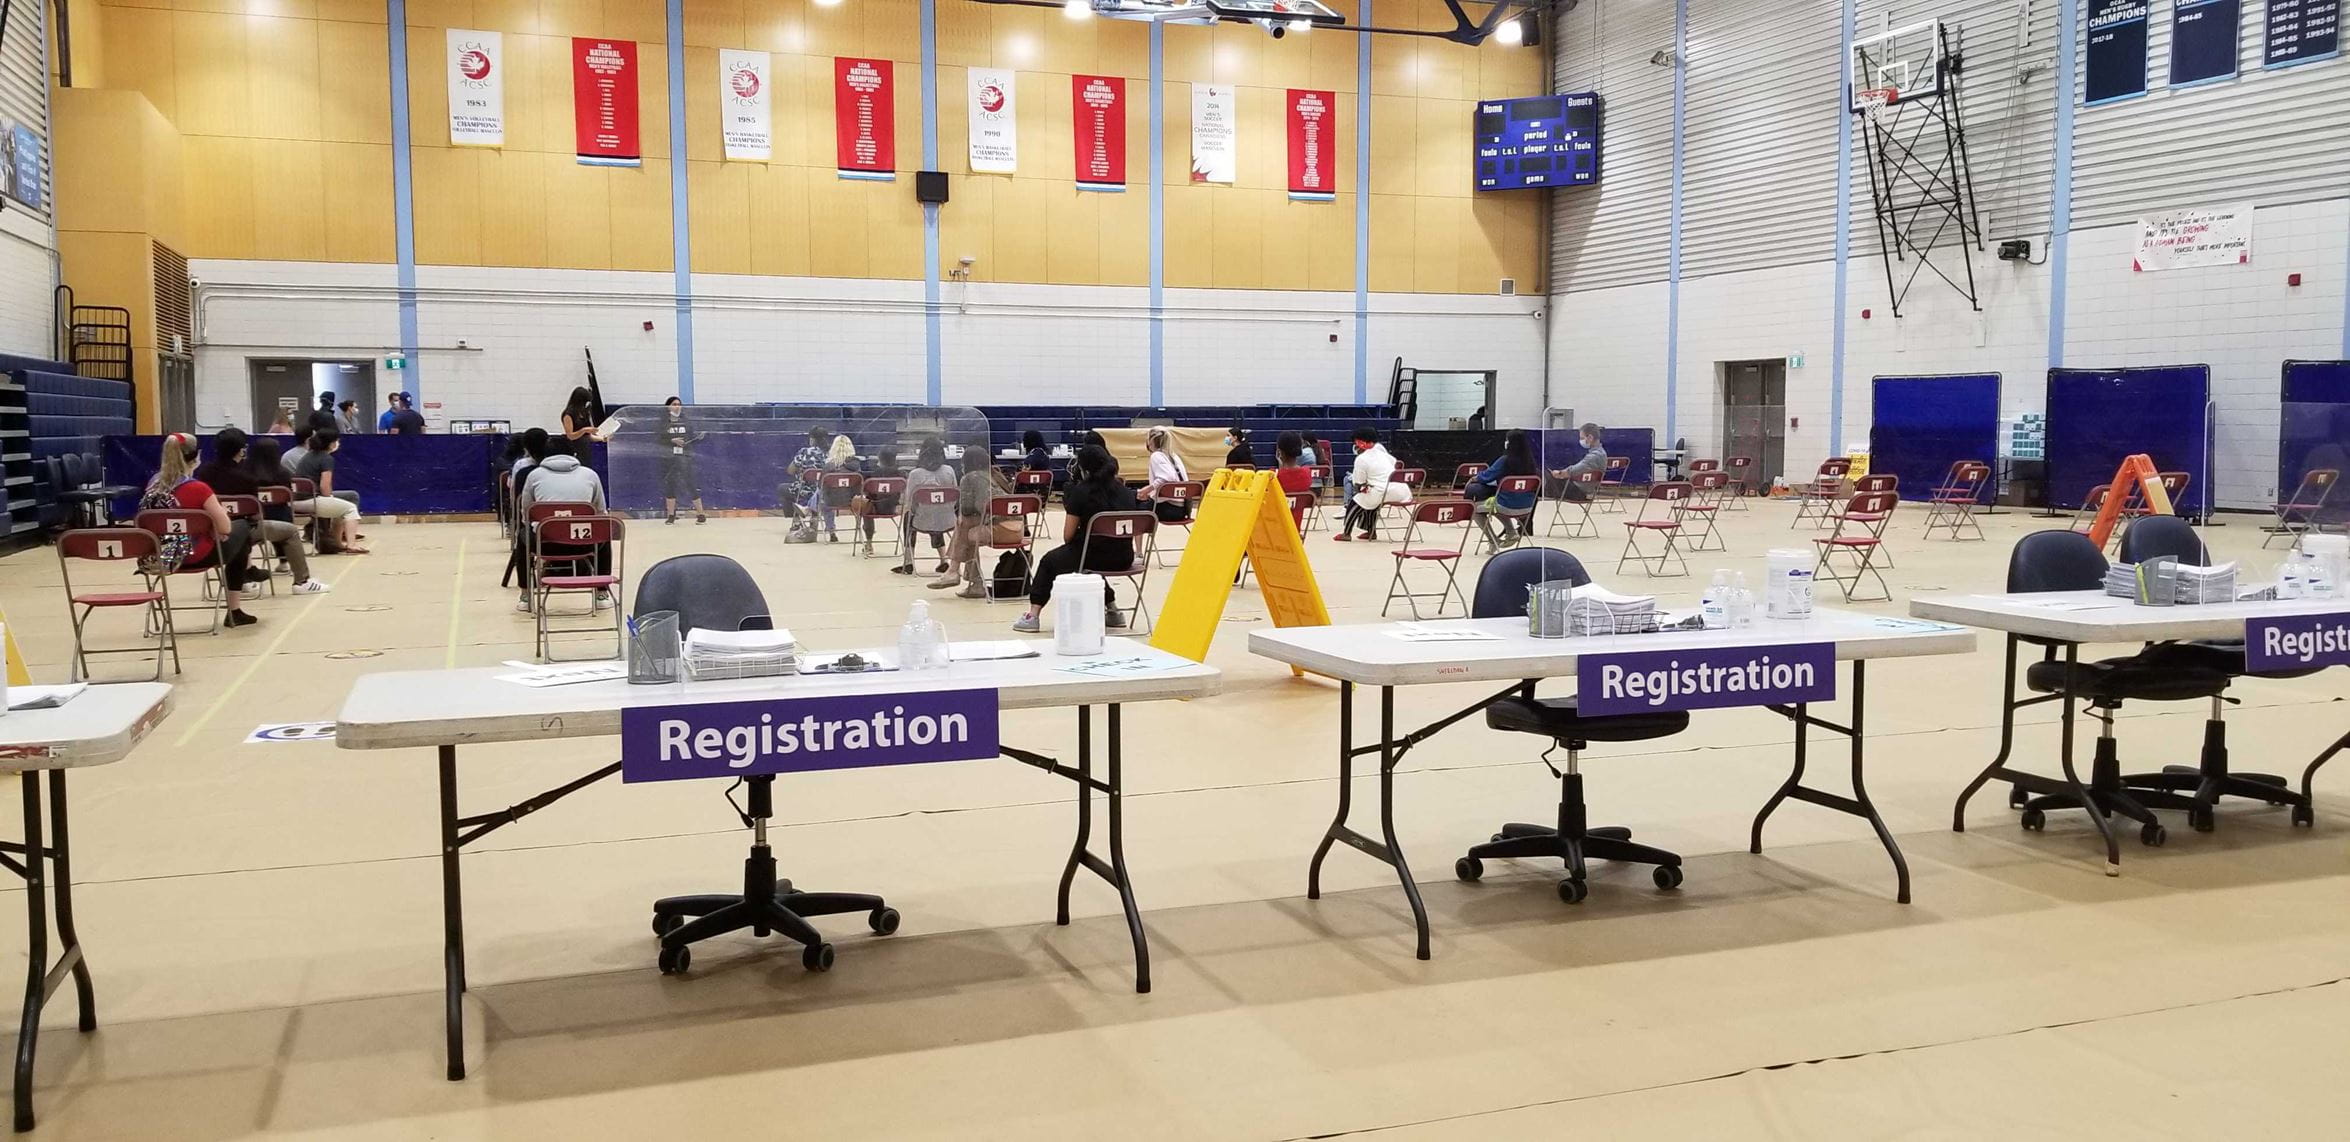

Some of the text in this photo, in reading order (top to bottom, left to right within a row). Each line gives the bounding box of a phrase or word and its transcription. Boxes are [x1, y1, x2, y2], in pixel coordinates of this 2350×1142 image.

[2089, 6, 2147, 27] CHAMPIONS
[457, 41, 490, 55] CCAA
[589, 48, 620, 57] NATIONAL
[585, 56, 624, 66] CHAMPIONS
[729, 60, 759, 74] CCAA
[850, 68, 878, 76] NATIONAL
[847, 75, 882, 84] CHAMPIONS
[978, 77, 1005, 90] CCAA
[1568, 97, 1593, 107] Guests
[1483, 104, 1503, 114] Home
[1194, 126, 1232, 135] CHAMPIONS
[1524, 130, 1547, 141] period
[1523, 144, 1547, 154] player
[1574, 141, 1591, 150] fouls
[1481, 149, 1497, 157] fouls
[1526, 175, 1544, 184] game
[2183, 225, 2209, 234] GROWING
[2177, 236, 2195, 244] BEING
[262, 493, 269, 502] 4
[1176, 489, 1185, 497] 10
[934, 495, 941, 503] 3
[226, 504, 233, 513] 3
[1012, 505, 1018, 514] 2
[1441, 510, 1453, 521] 12
[172, 522, 181, 533] 2
[1121, 524, 1128, 534] 1
[573, 527, 591, 539] 12
[106, 545, 114, 558] 1
[2264, 623, 2350, 662] Regist
[1602, 655, 1814, 706] Registration
[658, 705, 969, 768] Registration
